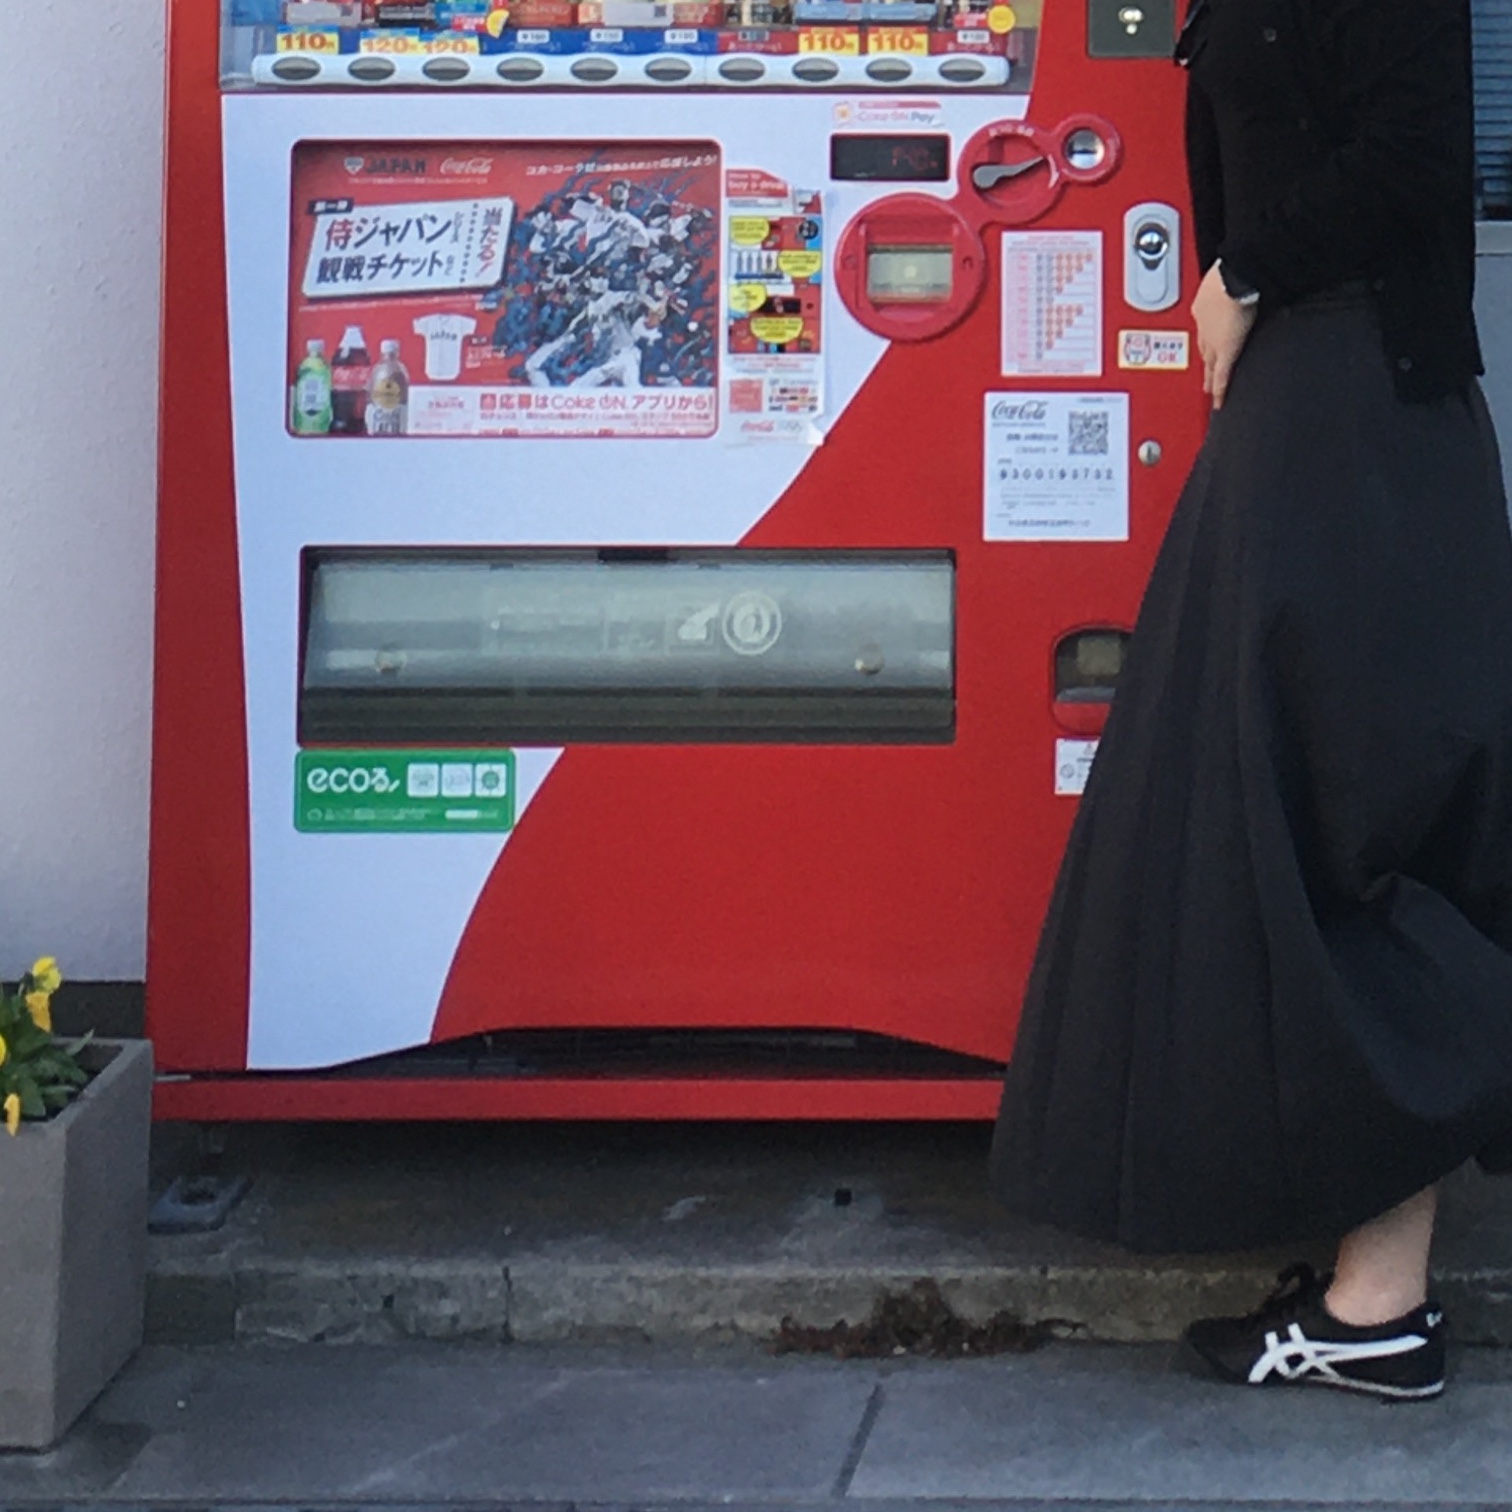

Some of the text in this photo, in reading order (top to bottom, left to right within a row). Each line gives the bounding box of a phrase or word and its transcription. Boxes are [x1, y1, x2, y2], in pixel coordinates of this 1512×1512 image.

[325, 214, 453, 252] 侍ジャパン
[475, 207, 504, 279] 当たる!
[316, 250, 444, 285] 観戦チケット
